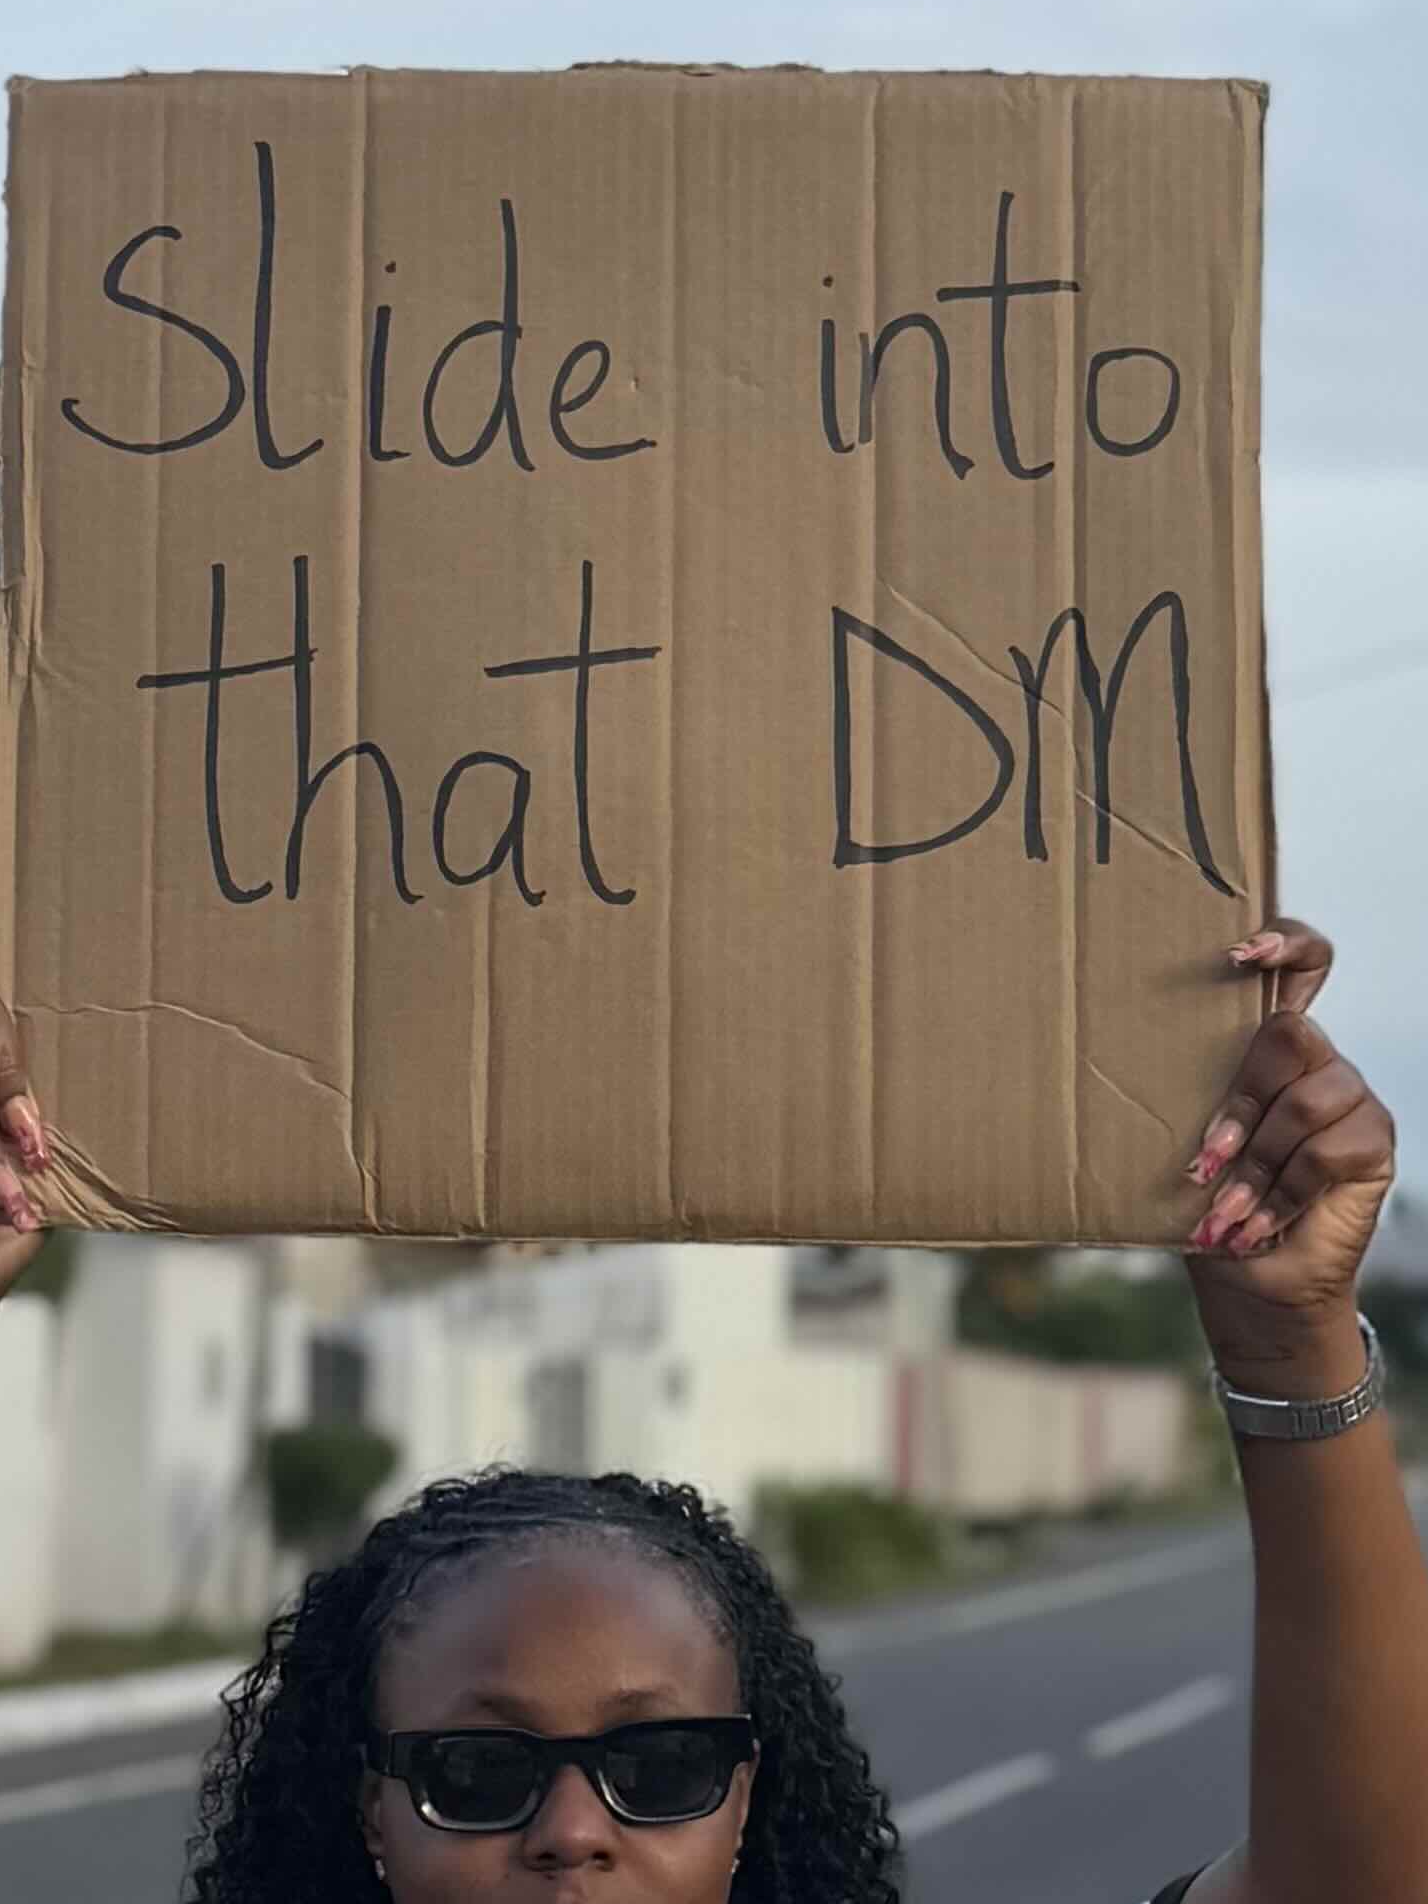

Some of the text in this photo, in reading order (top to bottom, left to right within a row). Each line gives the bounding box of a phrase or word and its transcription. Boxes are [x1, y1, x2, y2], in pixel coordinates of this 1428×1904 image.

[61, 140, 1181, 481] Slide into
[135, 553, 1247, 907] that DM
